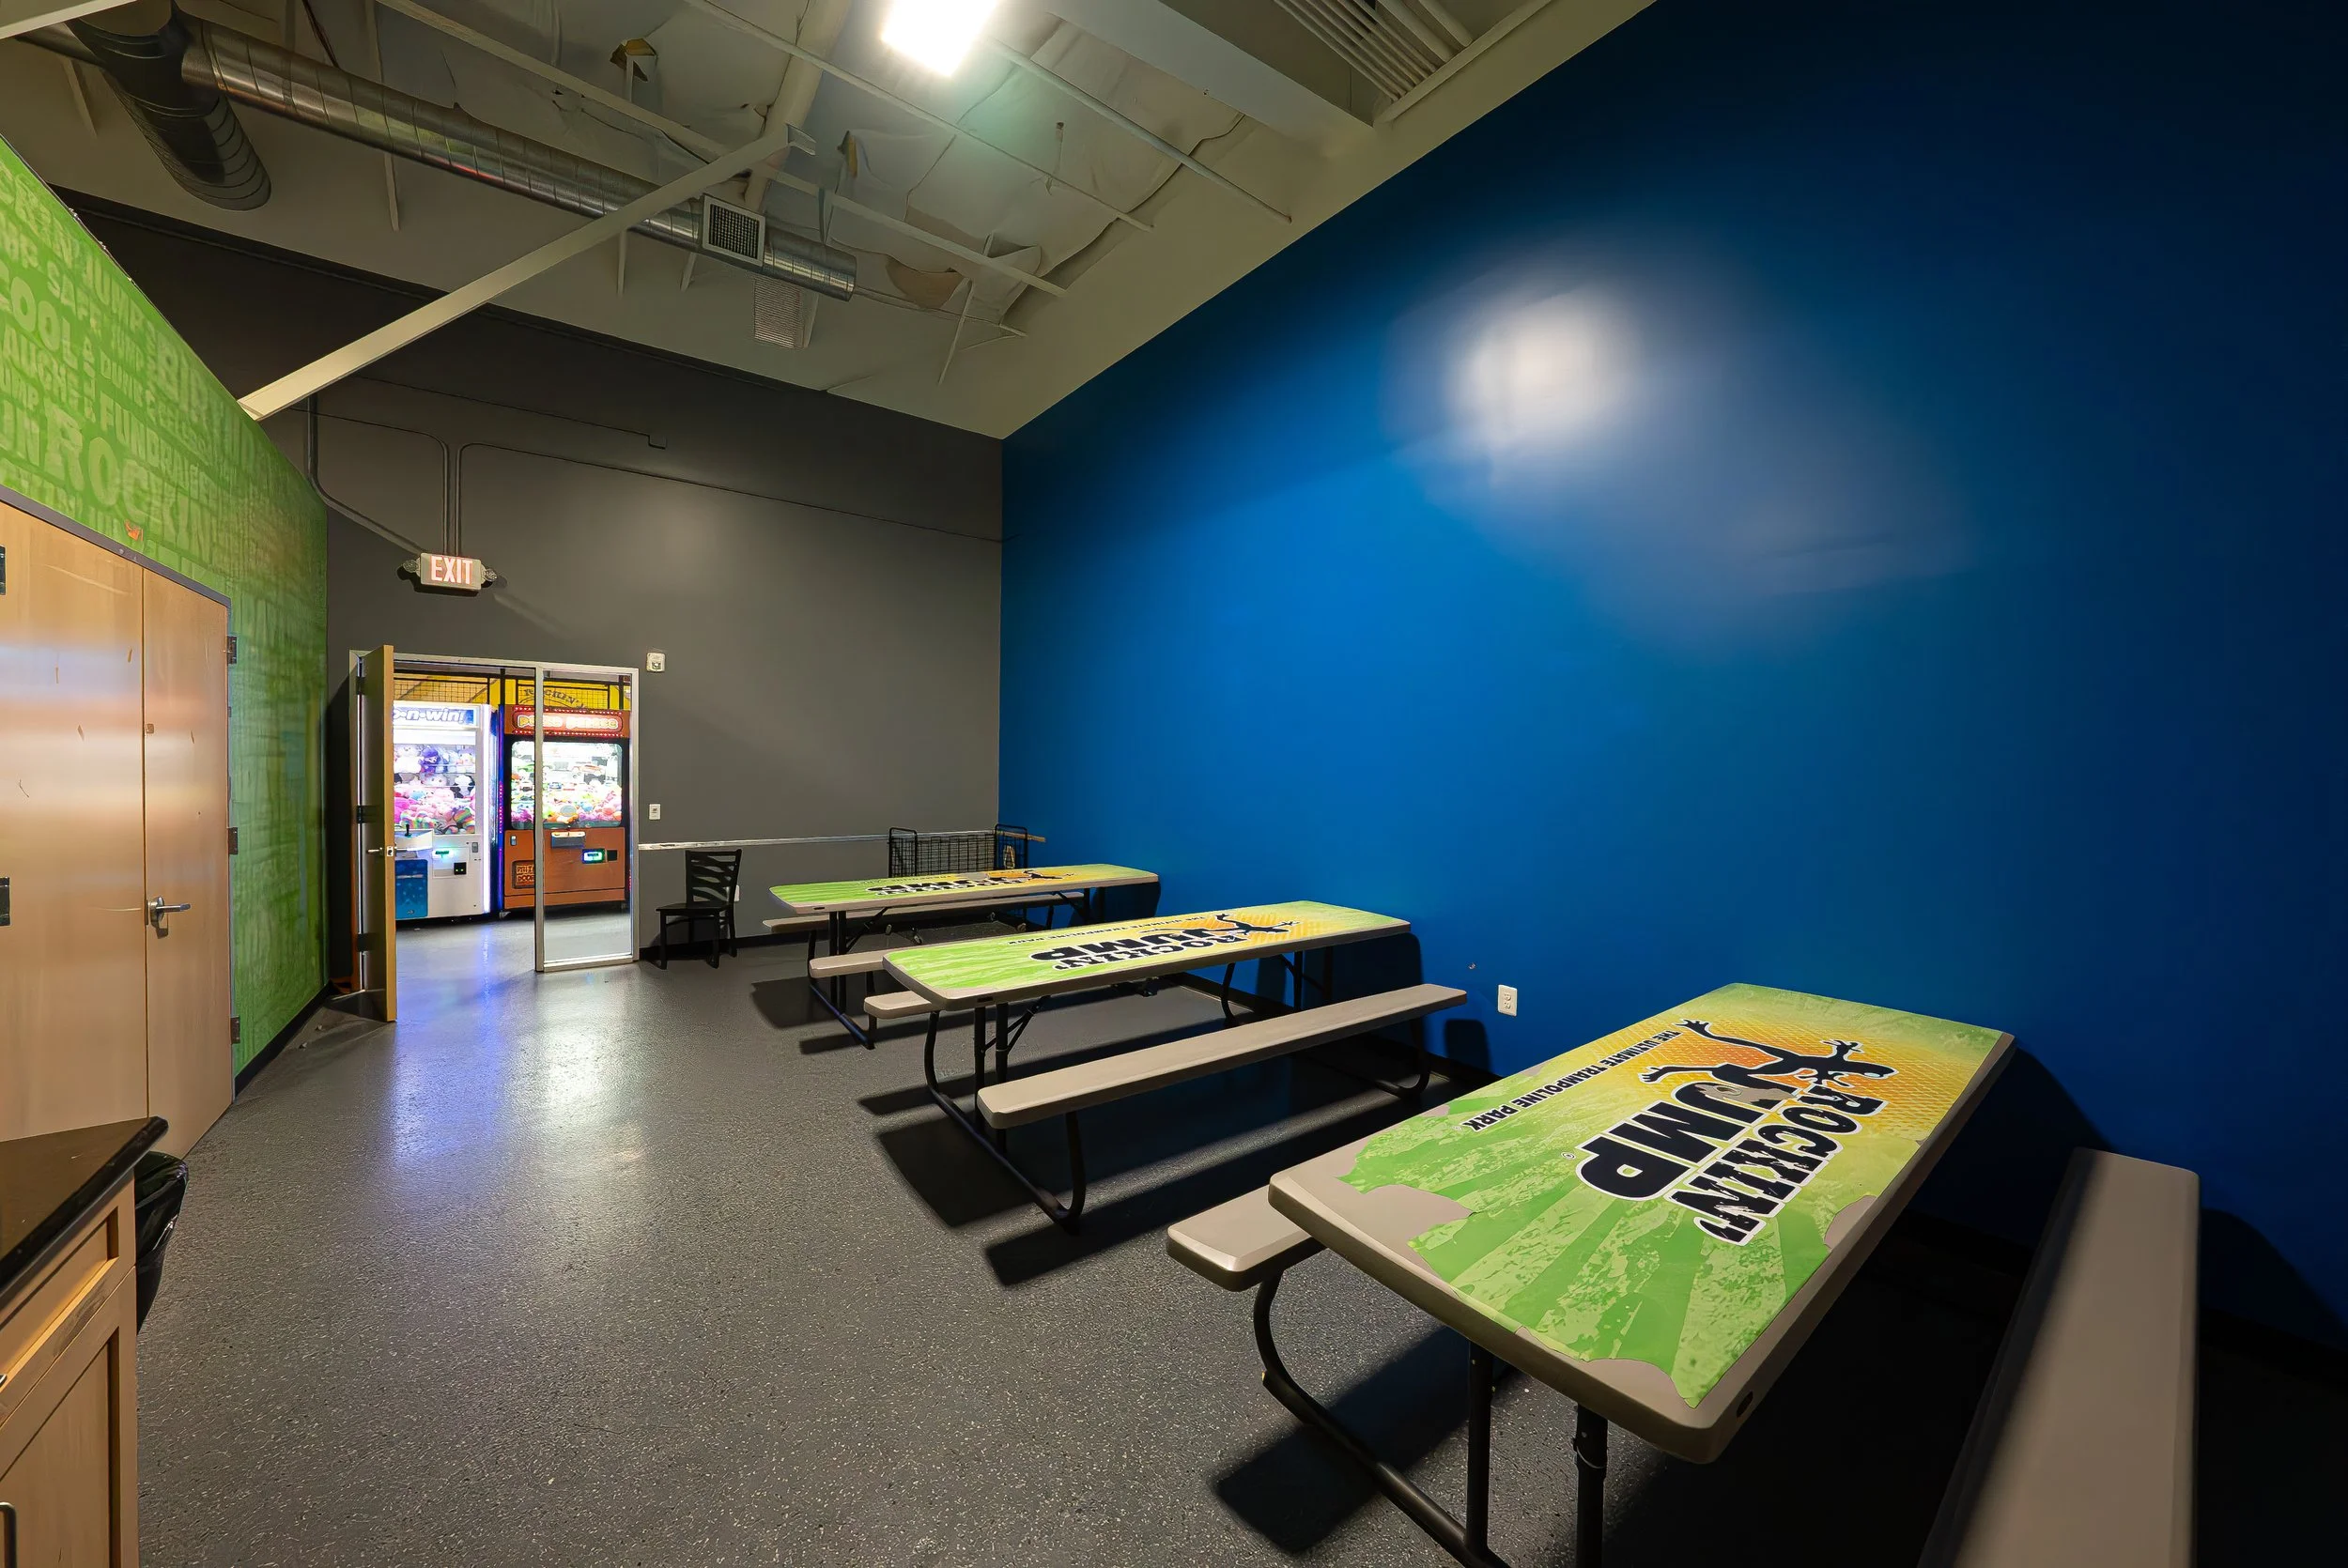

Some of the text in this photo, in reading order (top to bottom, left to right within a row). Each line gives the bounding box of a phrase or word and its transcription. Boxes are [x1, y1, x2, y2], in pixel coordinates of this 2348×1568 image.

[430, 555, 473, 584] EXIT
[1030, 928, 1216, 961] JUMP
[1054, 934, 1248, 970] ROCKIN'
[1462, 1029, 1682, 1131] THE ULTIMATE TRAMPOLINE PARK
[1579, 1064, 1801, 1200] JUMP
[1667, 1084, 1886, 1244] ROCKIN'
